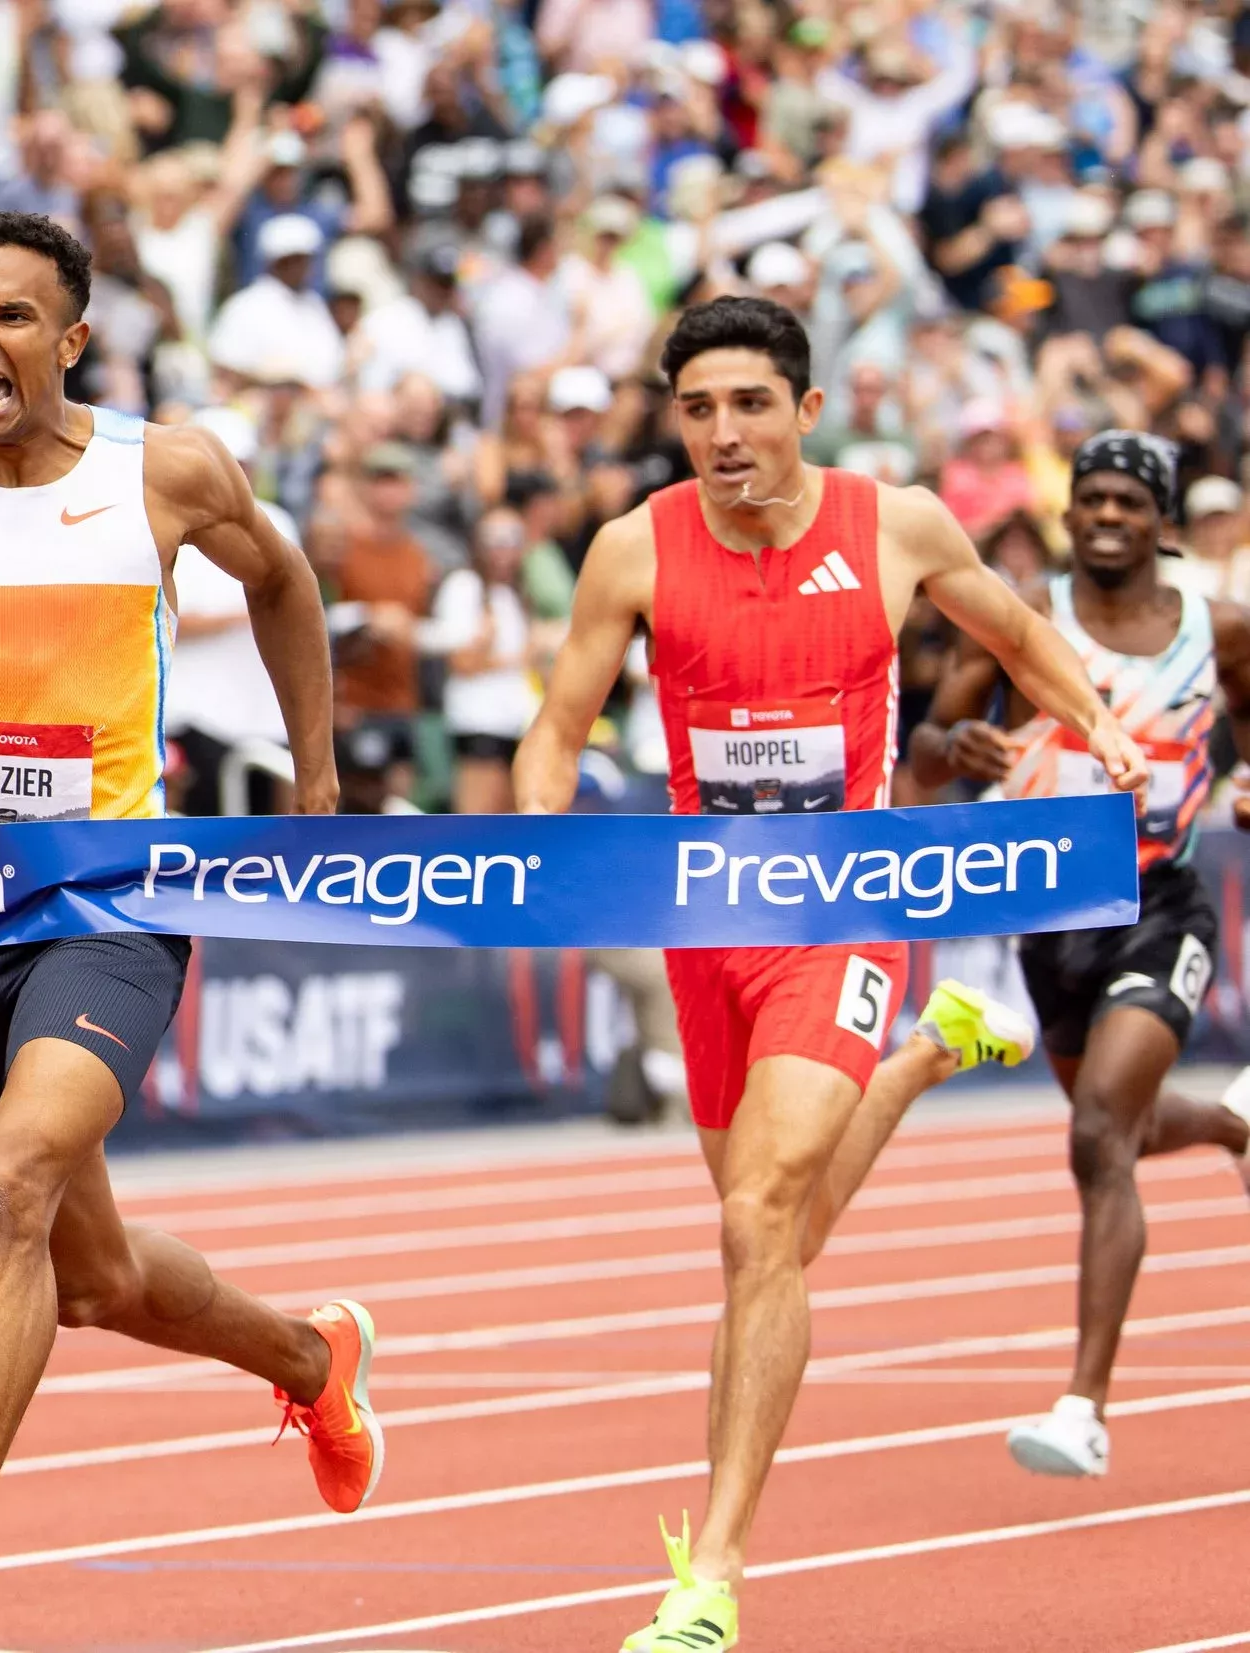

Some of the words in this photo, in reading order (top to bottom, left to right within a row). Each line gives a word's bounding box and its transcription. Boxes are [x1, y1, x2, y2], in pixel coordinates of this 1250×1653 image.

[751, 710, 794, 722] TOYOTA
[725, 740, 806, 766] HOPPEL
[851, 968, 884, 1034] 5
[202, 969, 405, 1099] USATF
